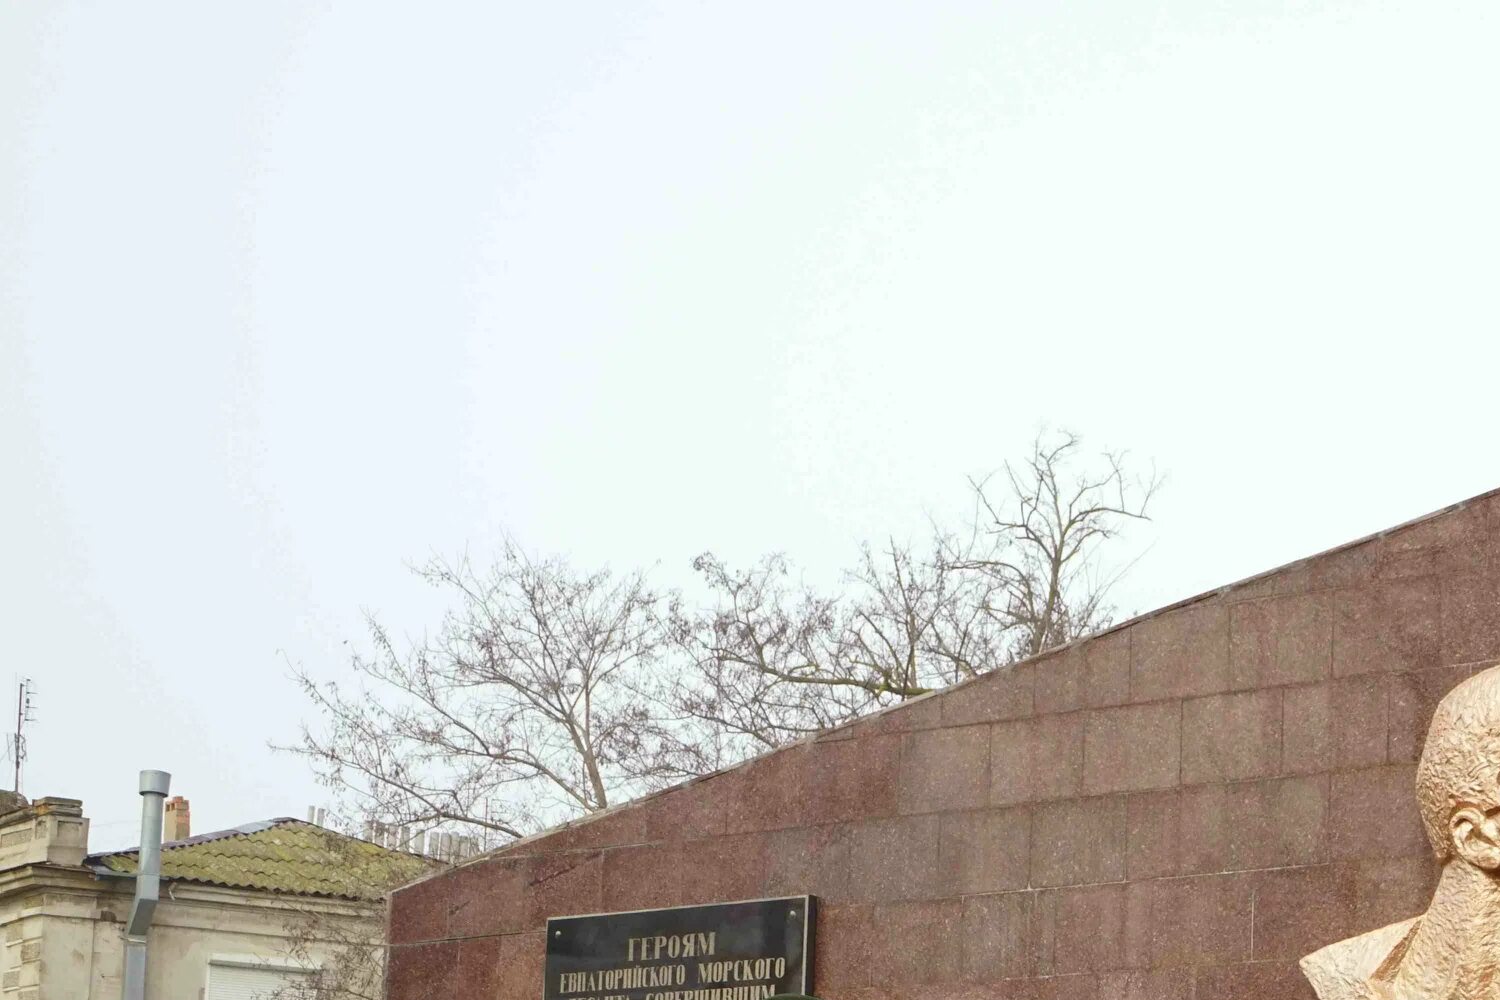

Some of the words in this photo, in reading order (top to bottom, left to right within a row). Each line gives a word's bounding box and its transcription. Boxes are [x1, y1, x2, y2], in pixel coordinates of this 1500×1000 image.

[627, 931, 716, 962] ГЕРОЯМ
[559, 964, 686, 994] ЕВПАТОРИЙСКОГО
[697, 957, 786, 984] МОРСКОГО
